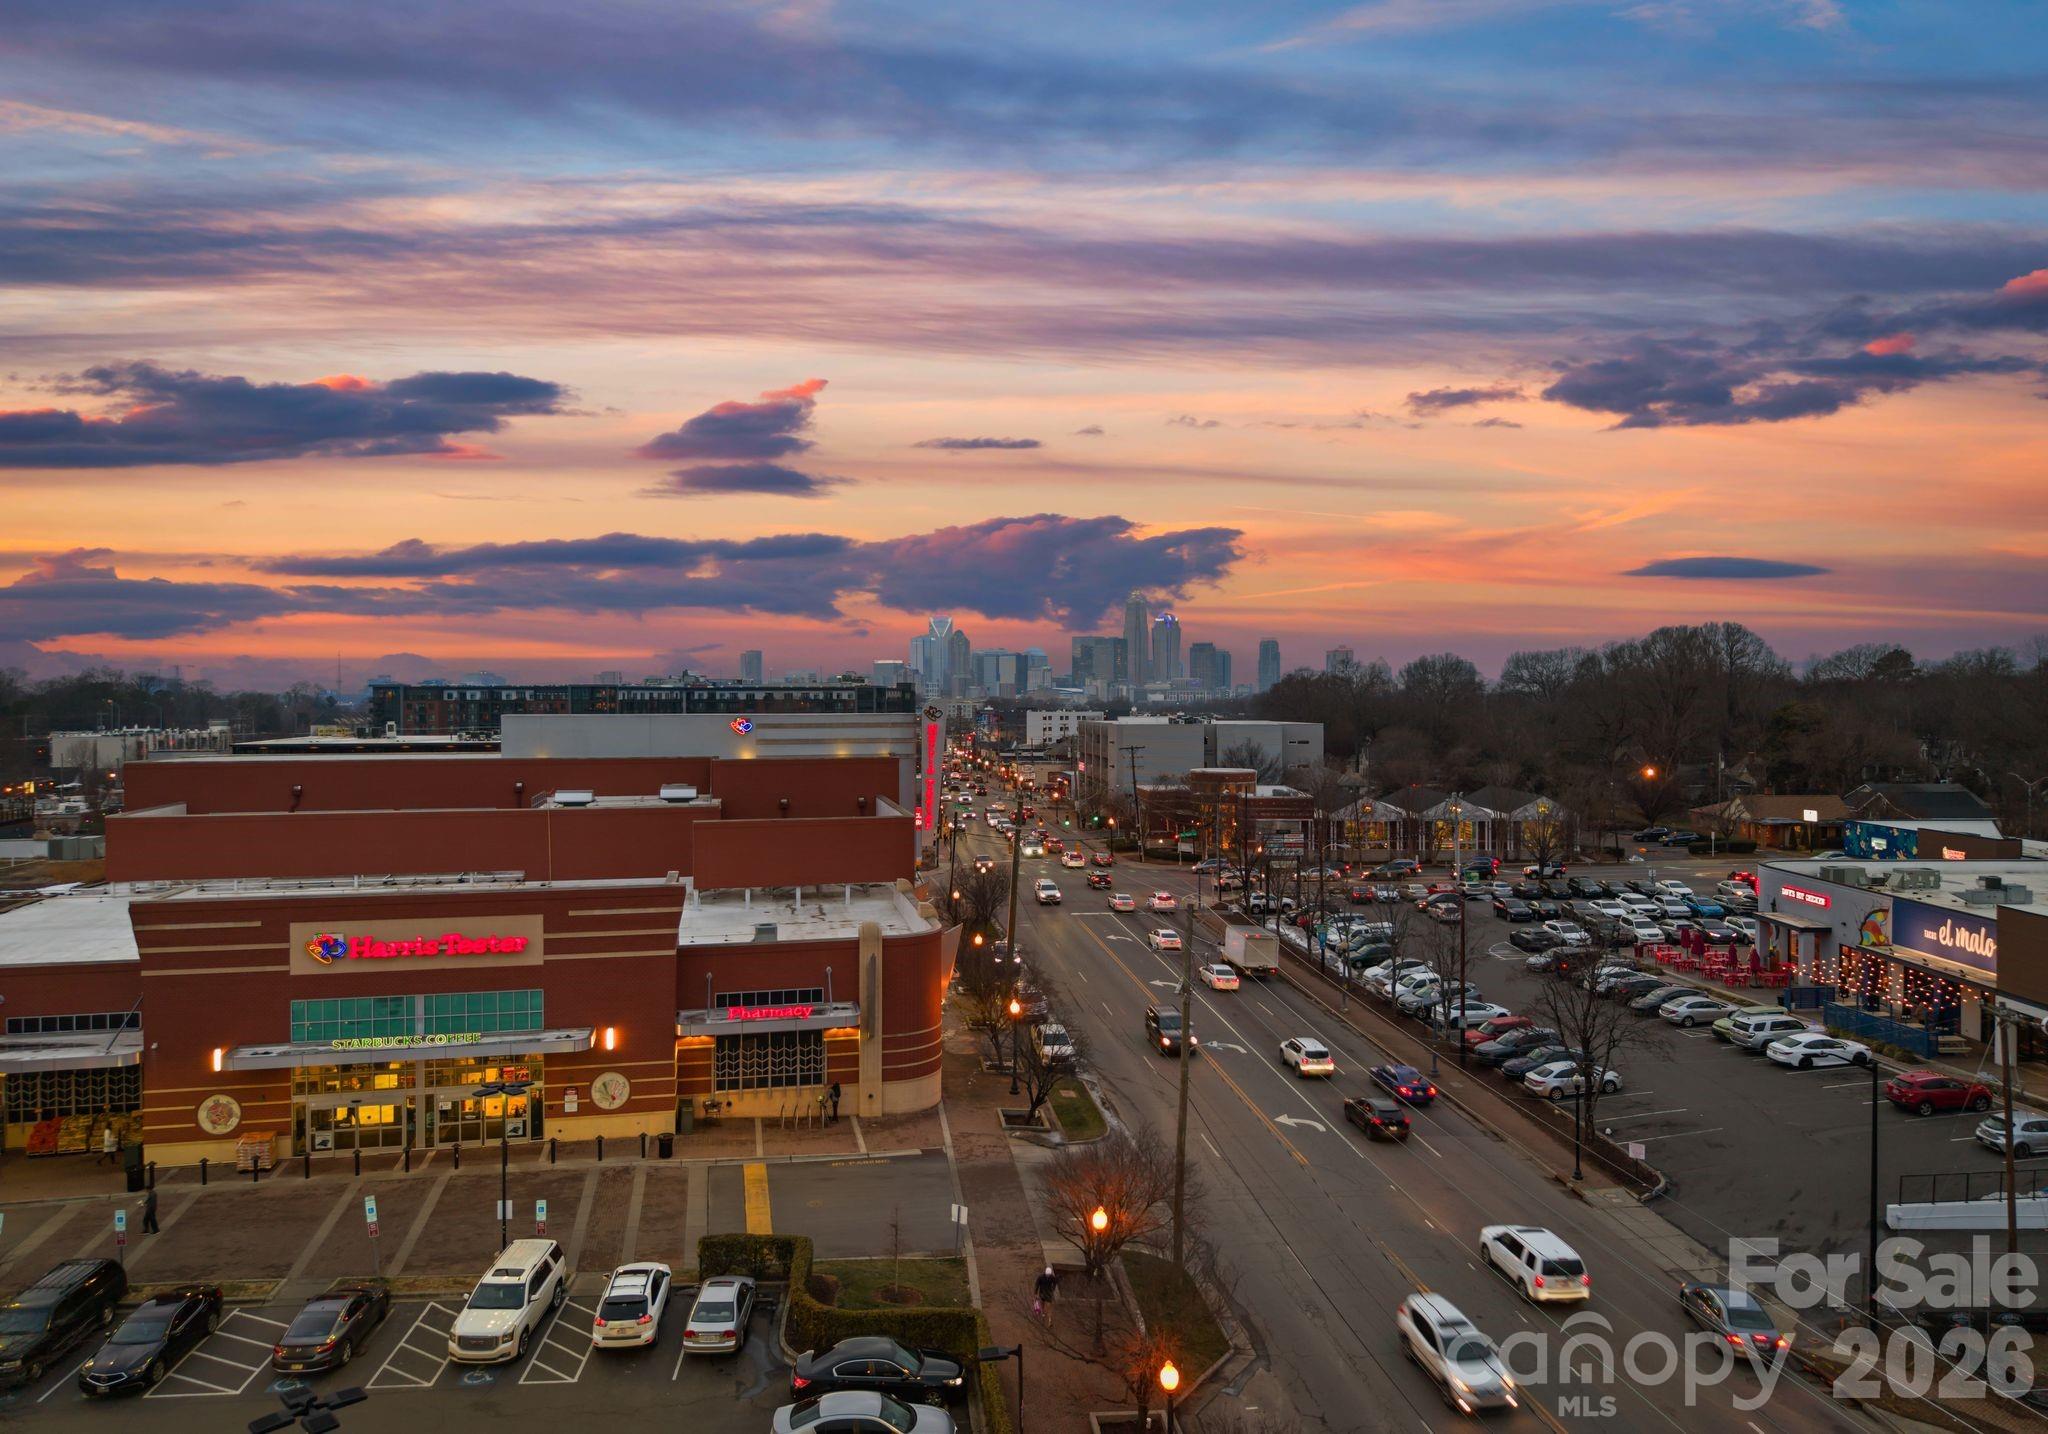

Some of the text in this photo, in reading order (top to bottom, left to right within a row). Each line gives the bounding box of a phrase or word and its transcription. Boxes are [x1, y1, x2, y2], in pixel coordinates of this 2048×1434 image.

[349, 932, 529, 959] Harris Teeter
[1939, 918, 1998, 958] el malo
[727, 1004, 813, 1021] Pharmacy
[332, 1032, 482, 1050] STARBUCKS COFFEE
